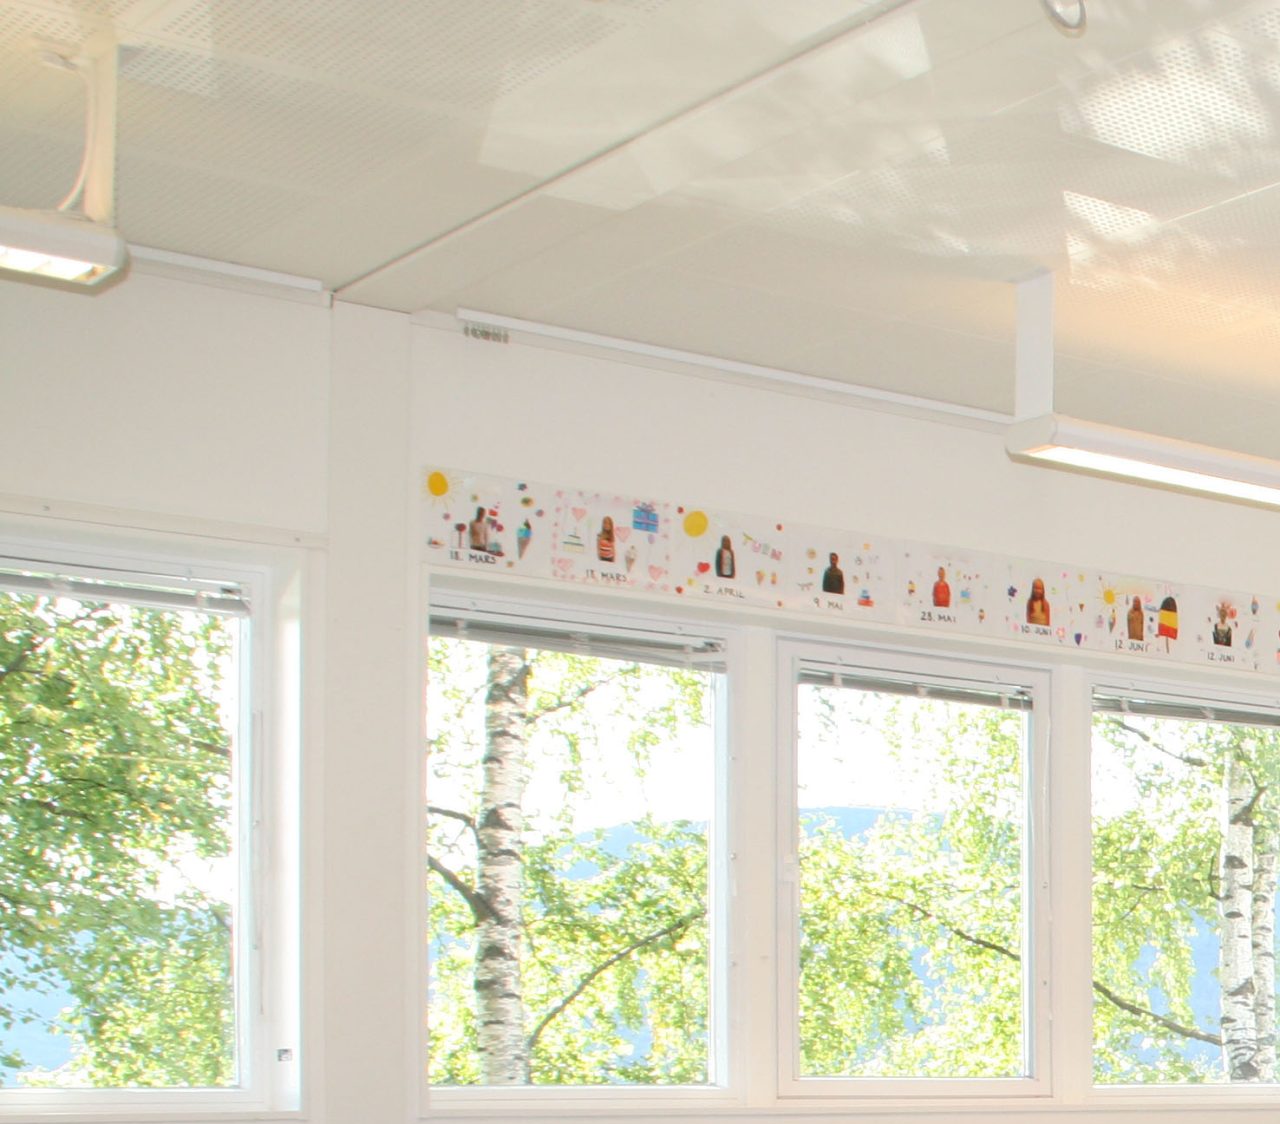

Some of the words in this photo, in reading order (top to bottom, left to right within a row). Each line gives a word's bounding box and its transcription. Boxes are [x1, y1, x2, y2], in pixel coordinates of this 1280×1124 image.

[468, 553, 496, 564] MARS
[601, 571, 627, 583] MARS
[716, 586, 745, 599] APRIL
[828, 600, 843, 611] MAI
[938, 614, 957, 623] MAI
[1034, 627, 1052, 637] JUNI
[1218, 653, 1235, 664] JUNI
